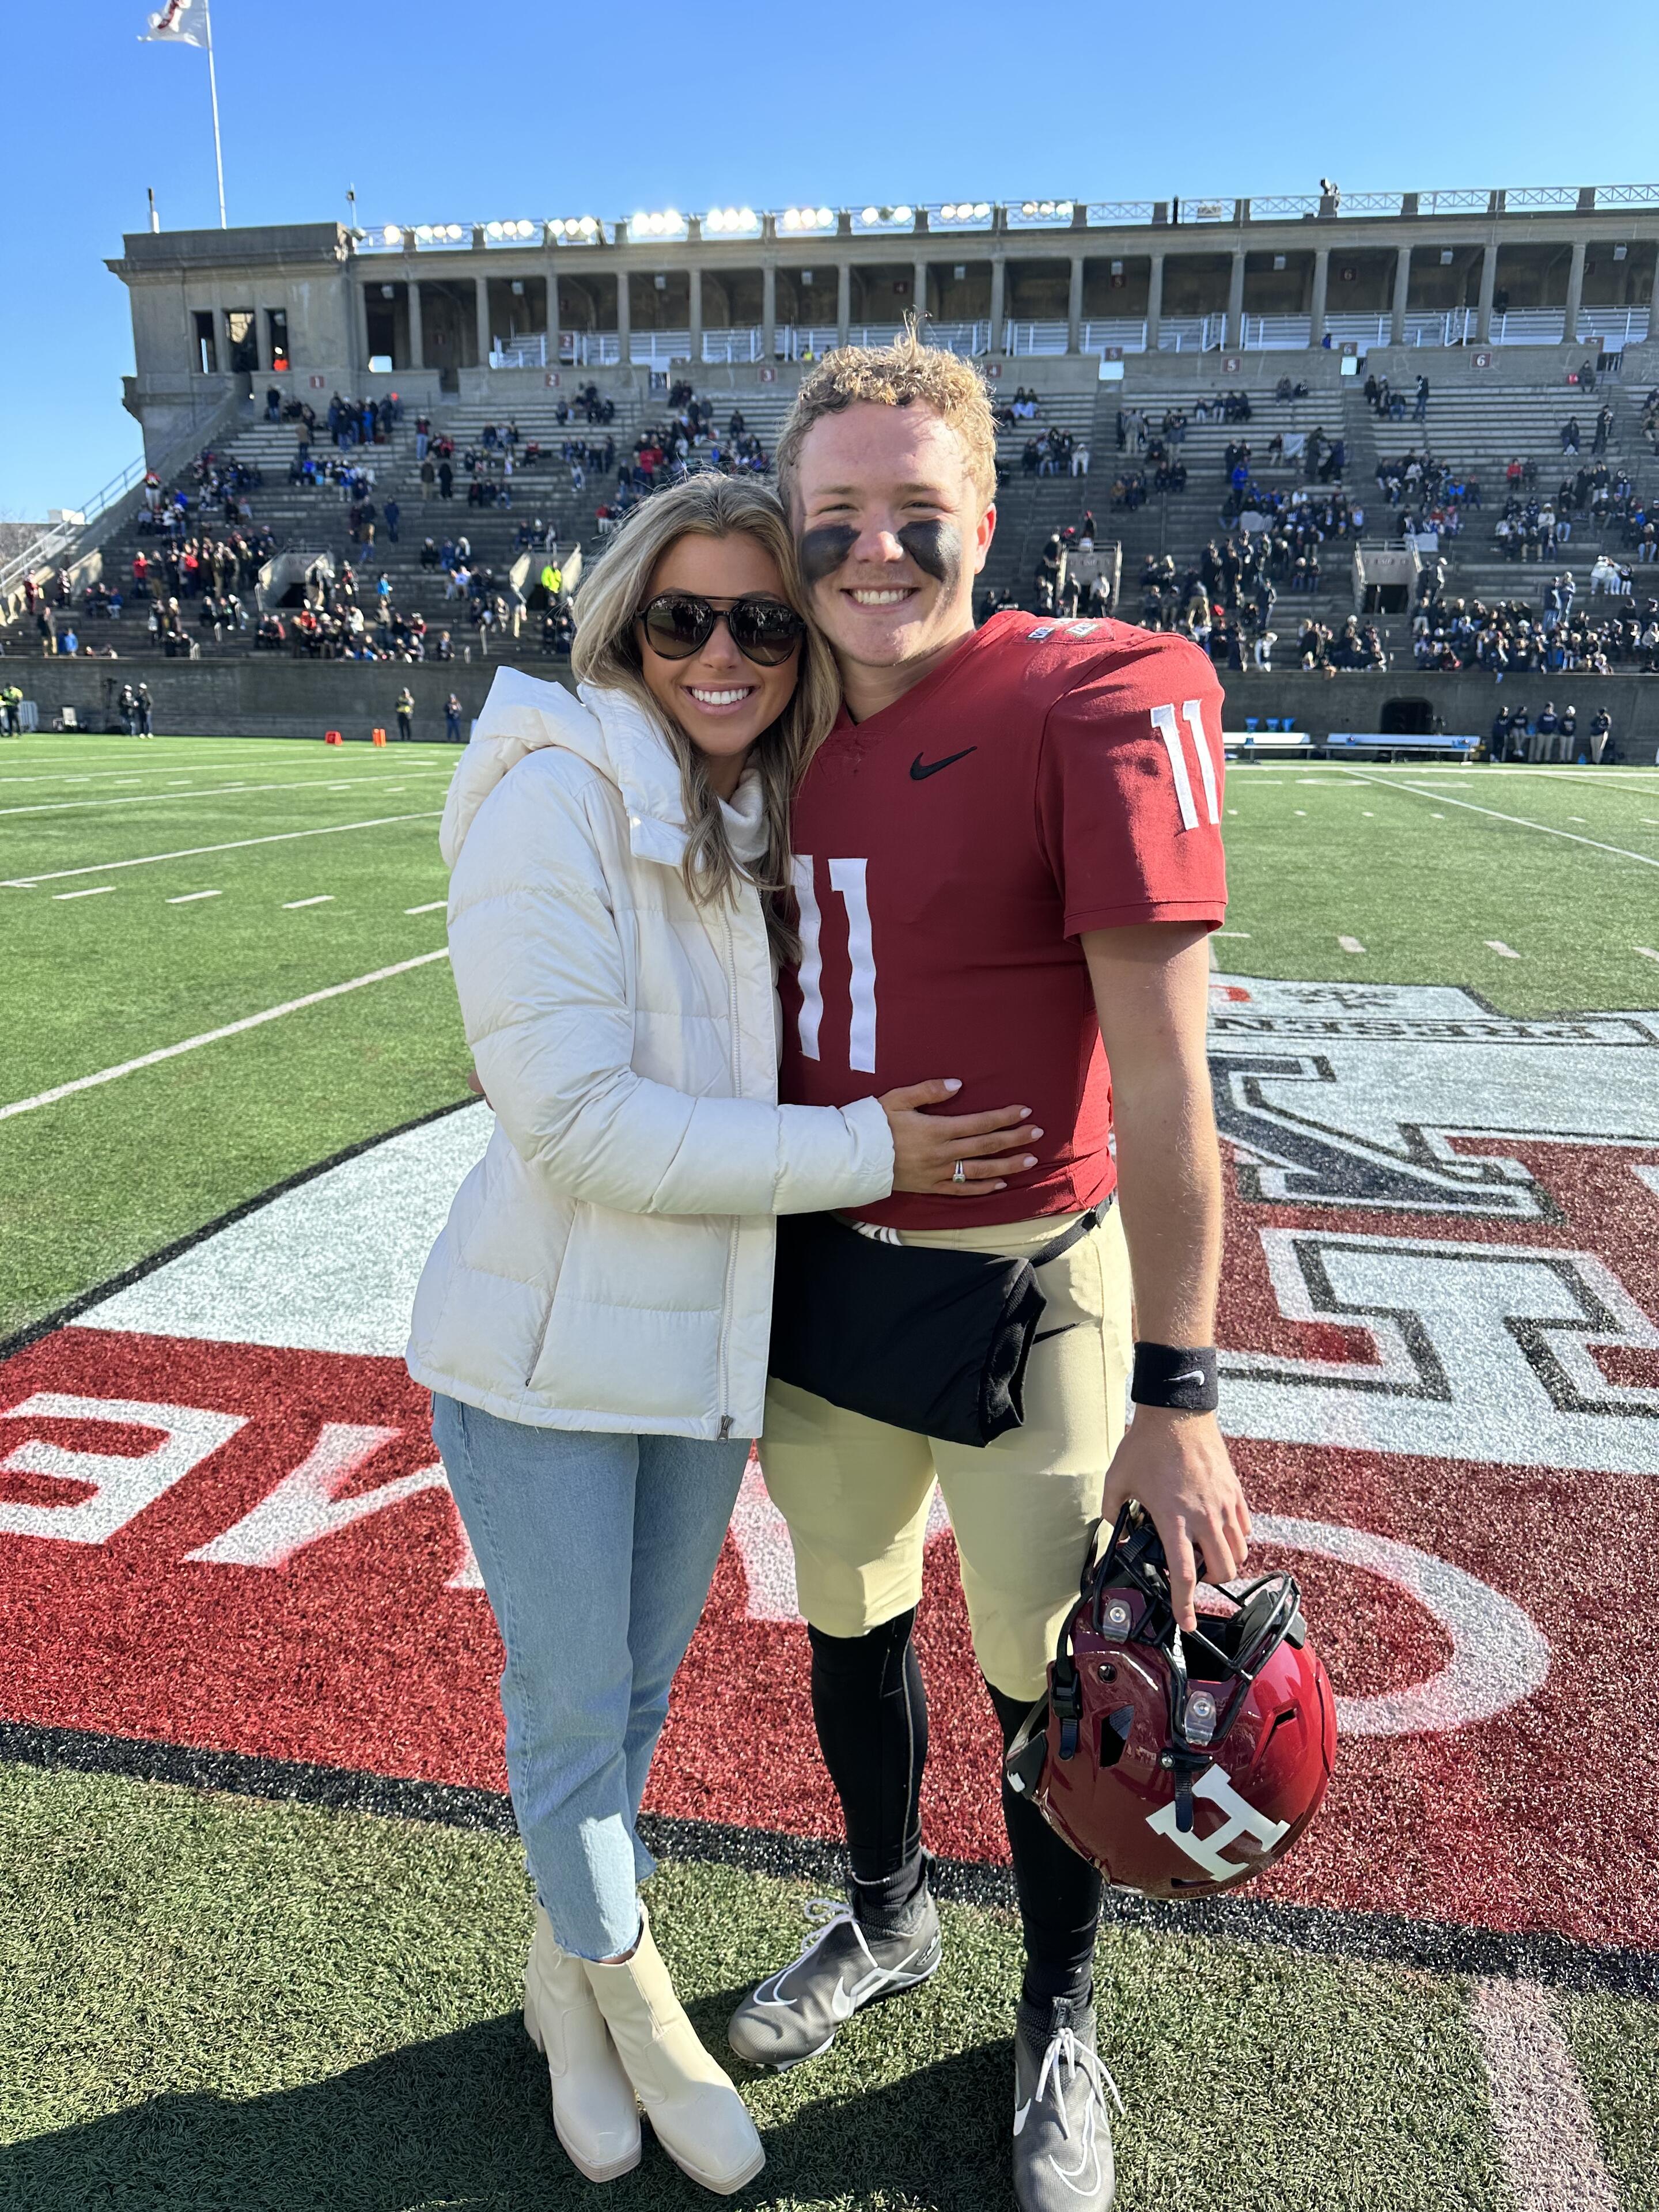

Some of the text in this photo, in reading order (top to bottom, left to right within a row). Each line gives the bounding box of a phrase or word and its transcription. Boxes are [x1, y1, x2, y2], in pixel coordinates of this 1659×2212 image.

[1343, 268, 1353, 281] 6
[1343, 343, 1352, 355] 6
[1227, 358, 1236, 372] 5
[1476, 354, 1486, 367] 6
[547, 374, 556, 387] 2
[763, 369, 771, 382] 3
[1150, 699, 1219, 831] 11
[791, 854, 876, 1073] 11
[1145, 1763, 1293, 1882] H
